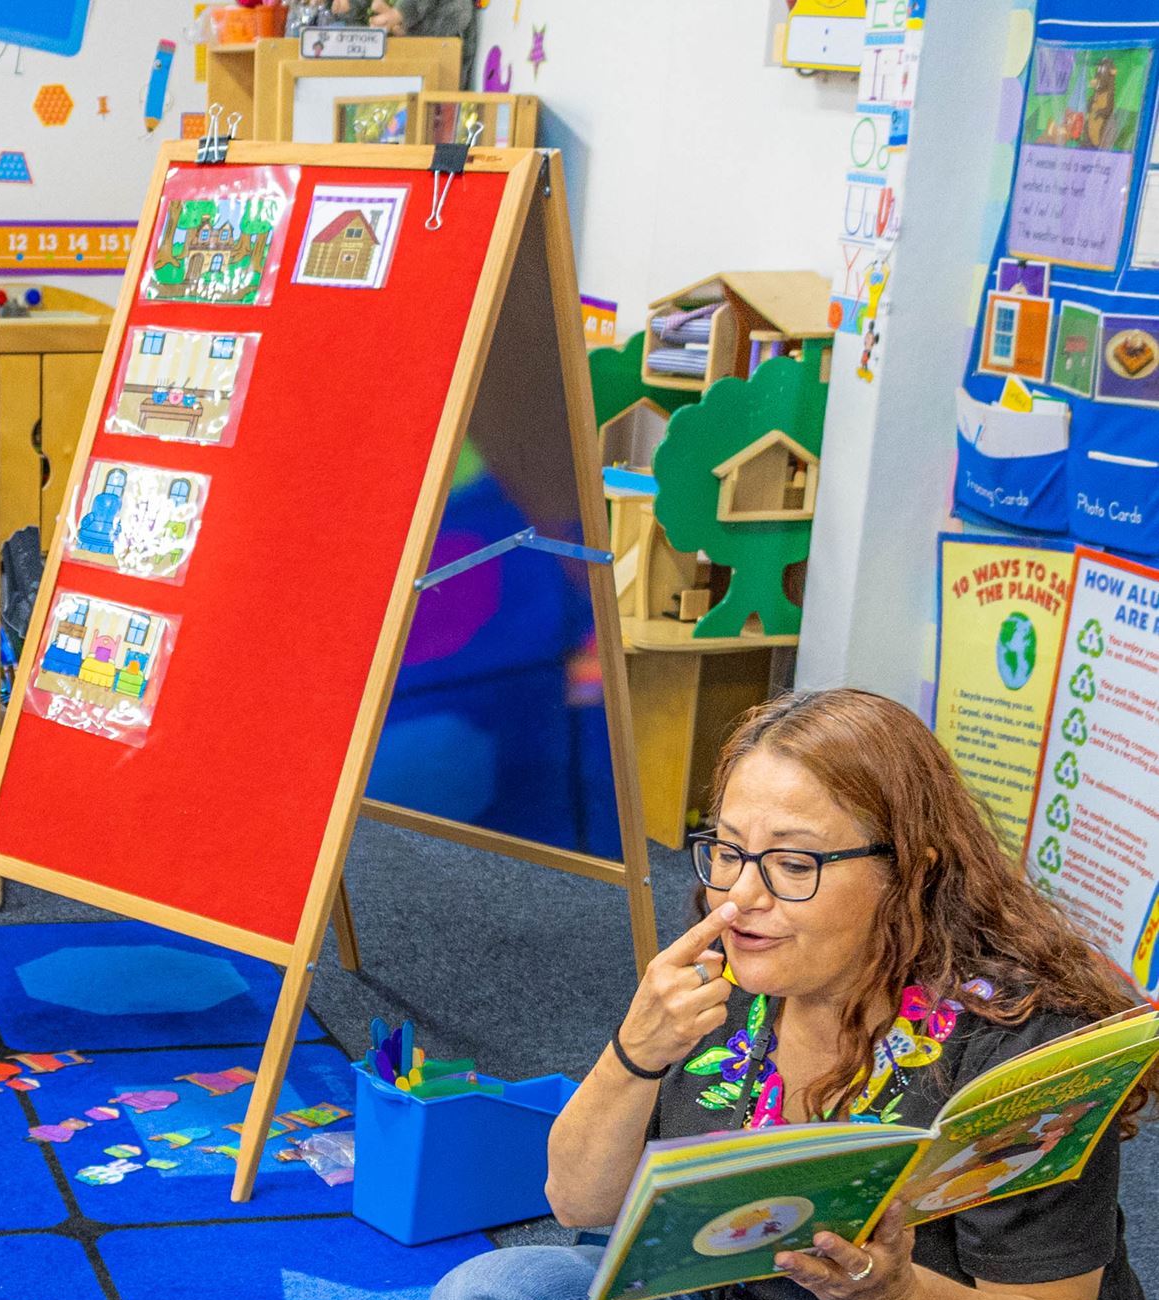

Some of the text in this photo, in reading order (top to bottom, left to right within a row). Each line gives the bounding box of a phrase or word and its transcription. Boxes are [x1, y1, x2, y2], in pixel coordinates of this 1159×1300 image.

[8, 234, 27, 251] 12
[38, 234, 58, 251] 13
[68, 234, 89, 251] 14
[99, 235, 119, 251] 15
[994, 487, 1029, 506] Cards
[1076, 492, 1142, 524] Photo Cards
[953, 576, 969, 599] 10
[972, 559, 1020, 585] WAYS
[1026, 560, 1046, 582] TO
[1084, 569, 1124, 597] HOW
[976, 581, 1061, 616] THE PLANET
[1114, 604, 1149, 631] ARE
[1123, 641, 1144, 657] enjoy
[1124, 656, 1158, 673] aluminum
[1098, 727, 1130, 748] recycling
[1096, 781, 1127, 800] aluminum
[1113, 822, 1142, 845] aluminum
[1137, 892, 1159, 961] COL
[948, 1071, 1090, 1142] Goldilocks
